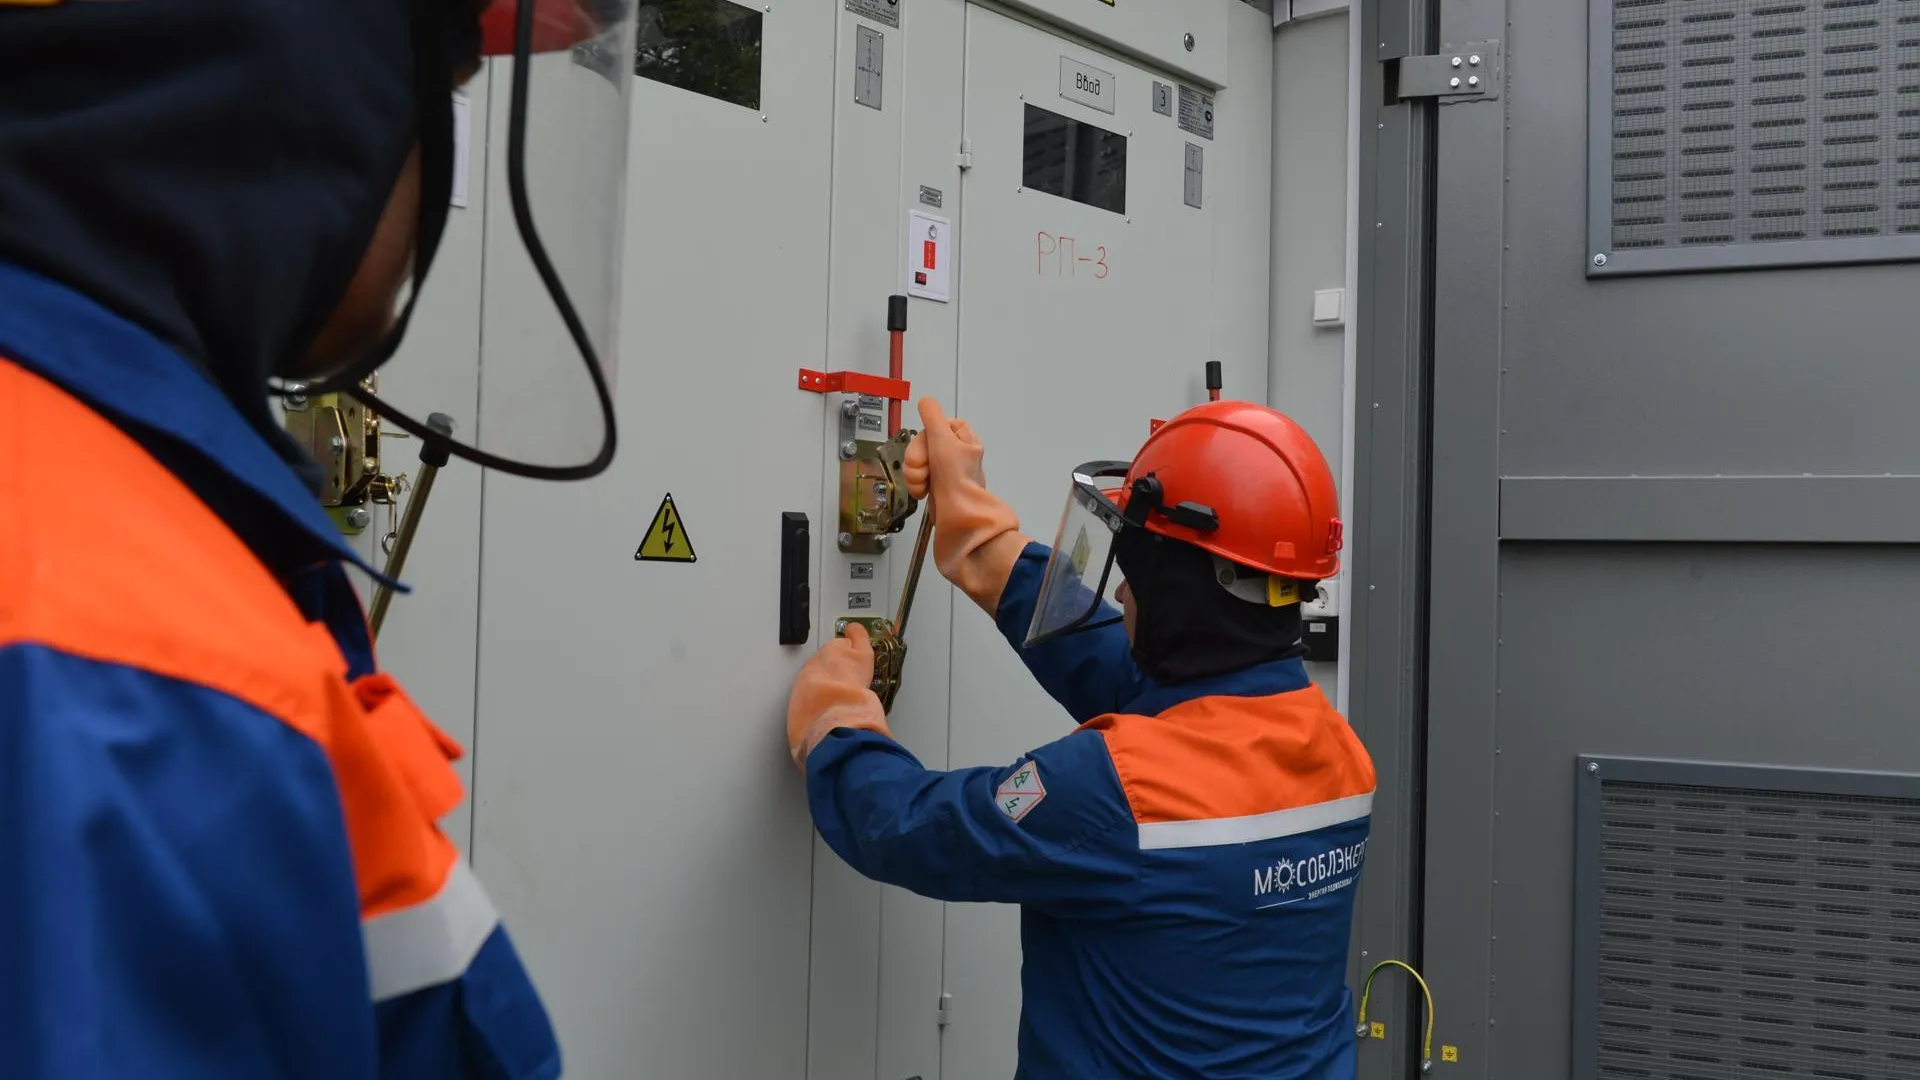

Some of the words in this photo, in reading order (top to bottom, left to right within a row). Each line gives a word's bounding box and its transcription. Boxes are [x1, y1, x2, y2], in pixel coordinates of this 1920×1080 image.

[1076, 72, 1100, 95] Ввод
[1160, 89, 1166, 107] 3
[1038, 231, 1108, 279] РП-3
